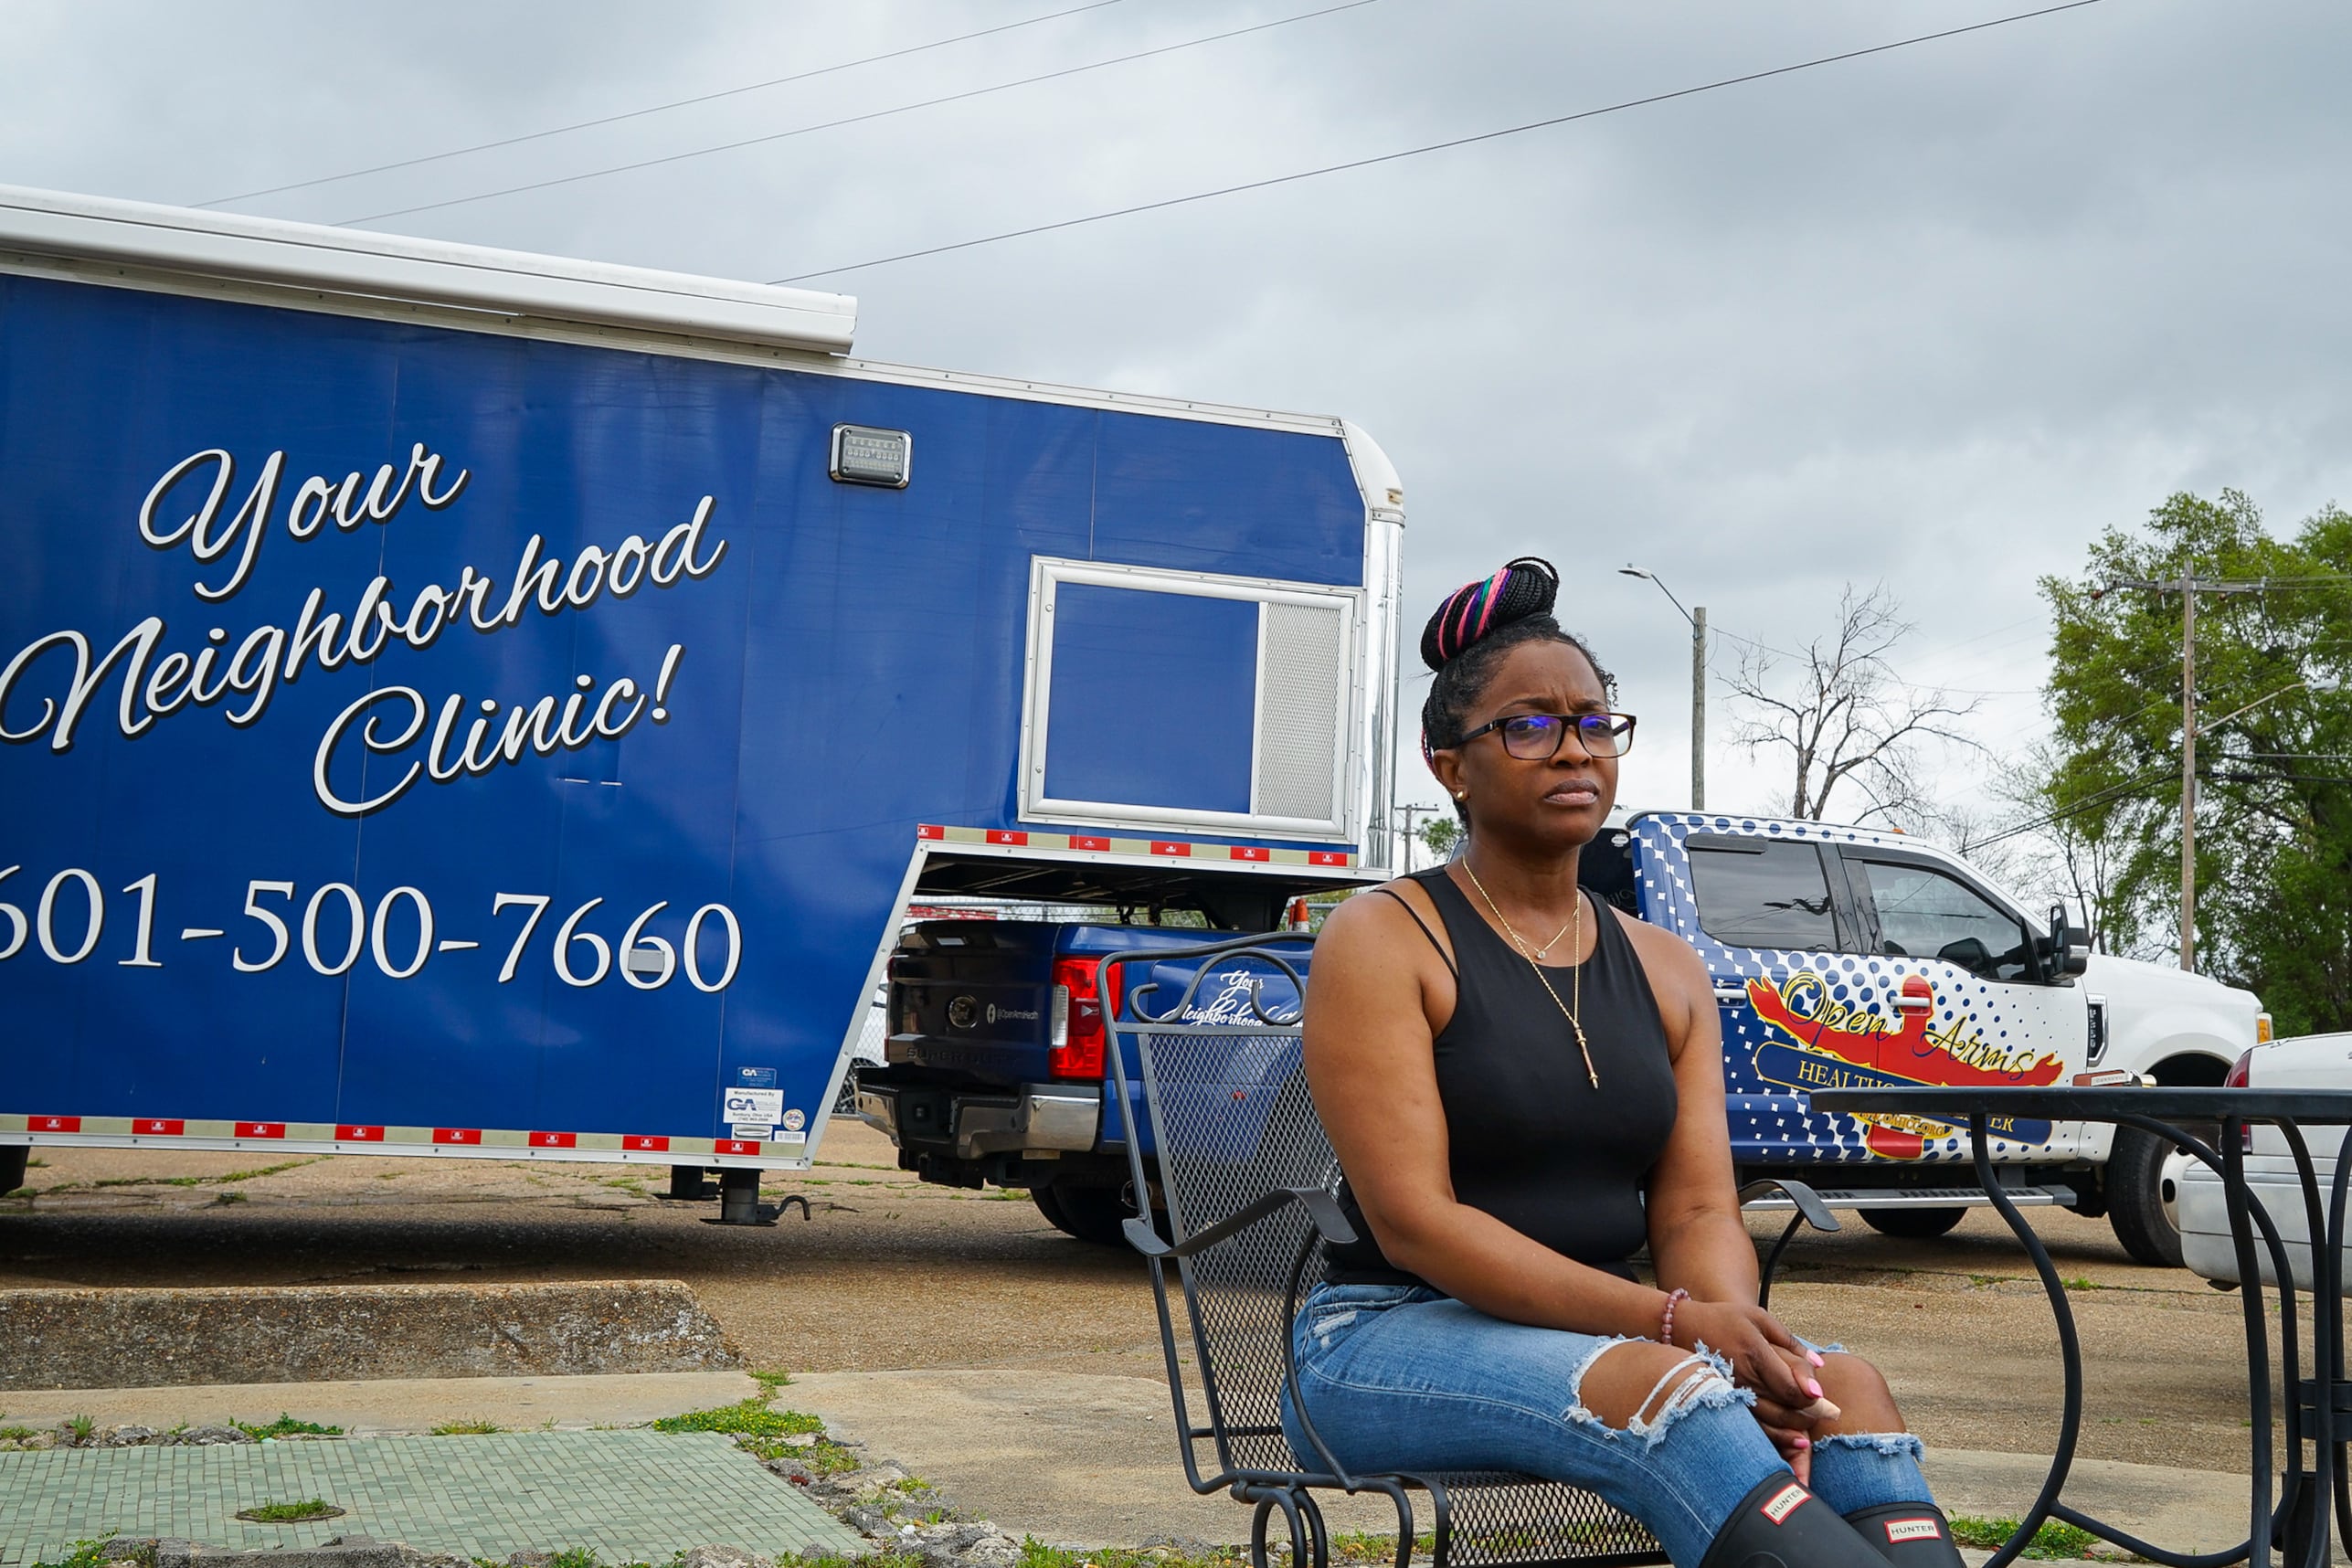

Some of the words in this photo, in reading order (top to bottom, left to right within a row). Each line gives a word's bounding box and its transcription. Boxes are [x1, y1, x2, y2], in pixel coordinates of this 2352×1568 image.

[138, 442, 467, 599] Your
[0, 494, 726, 751] Neighborhood
[313, 644, 683, 815] Clinic!
[1783, 971, 1893, 1051] Open
[1912, 1016, 2034, 1081] Arms
[1771, 1489, 1803, 1516] HUNTER
[1891, 1524, 1934, 1535] HUNTER
